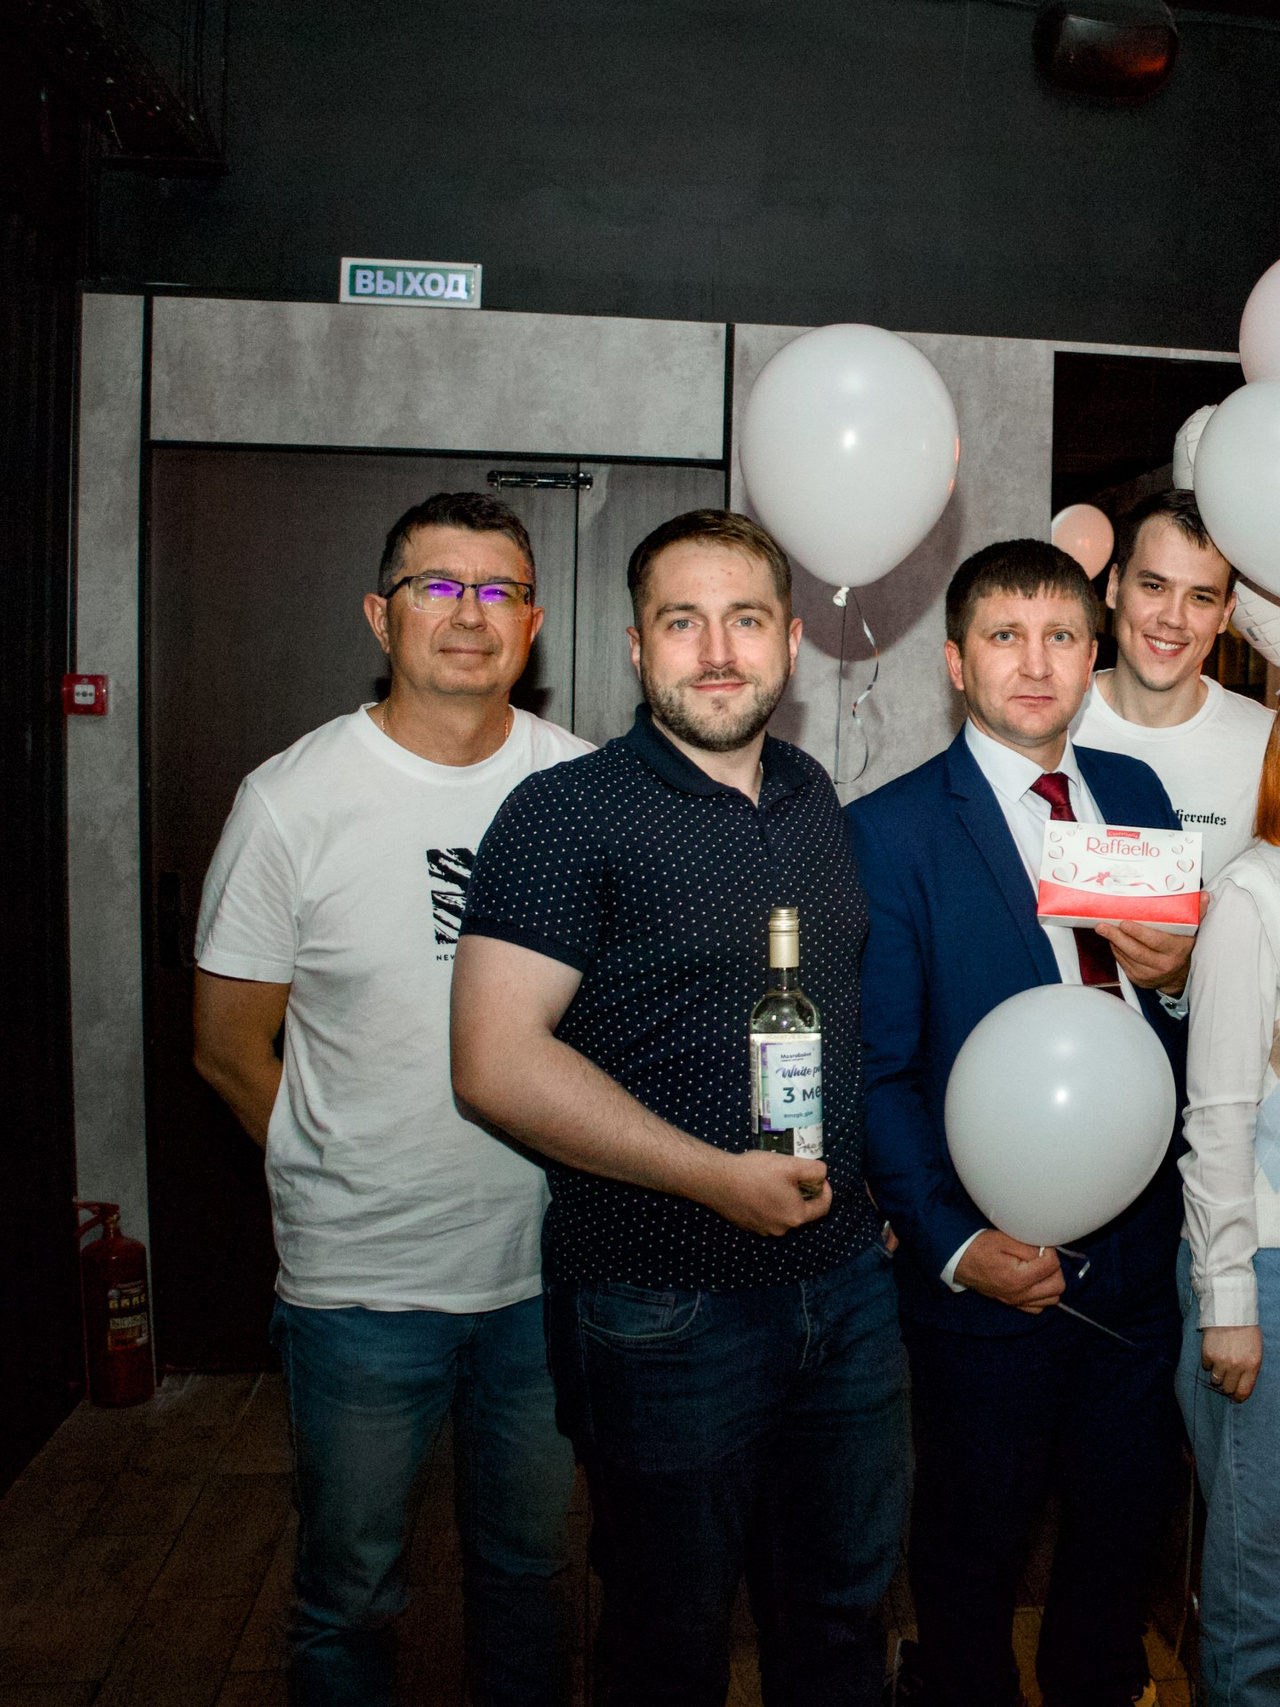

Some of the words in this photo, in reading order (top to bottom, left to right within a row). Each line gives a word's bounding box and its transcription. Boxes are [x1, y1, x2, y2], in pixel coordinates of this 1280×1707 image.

[355, 269, 468, 300] ВЫХОД
[1086, 836, 1160, 858] Raffaello
[776, 1064, 812, 1078] White
[782, 1086, 796, 1104] 3
